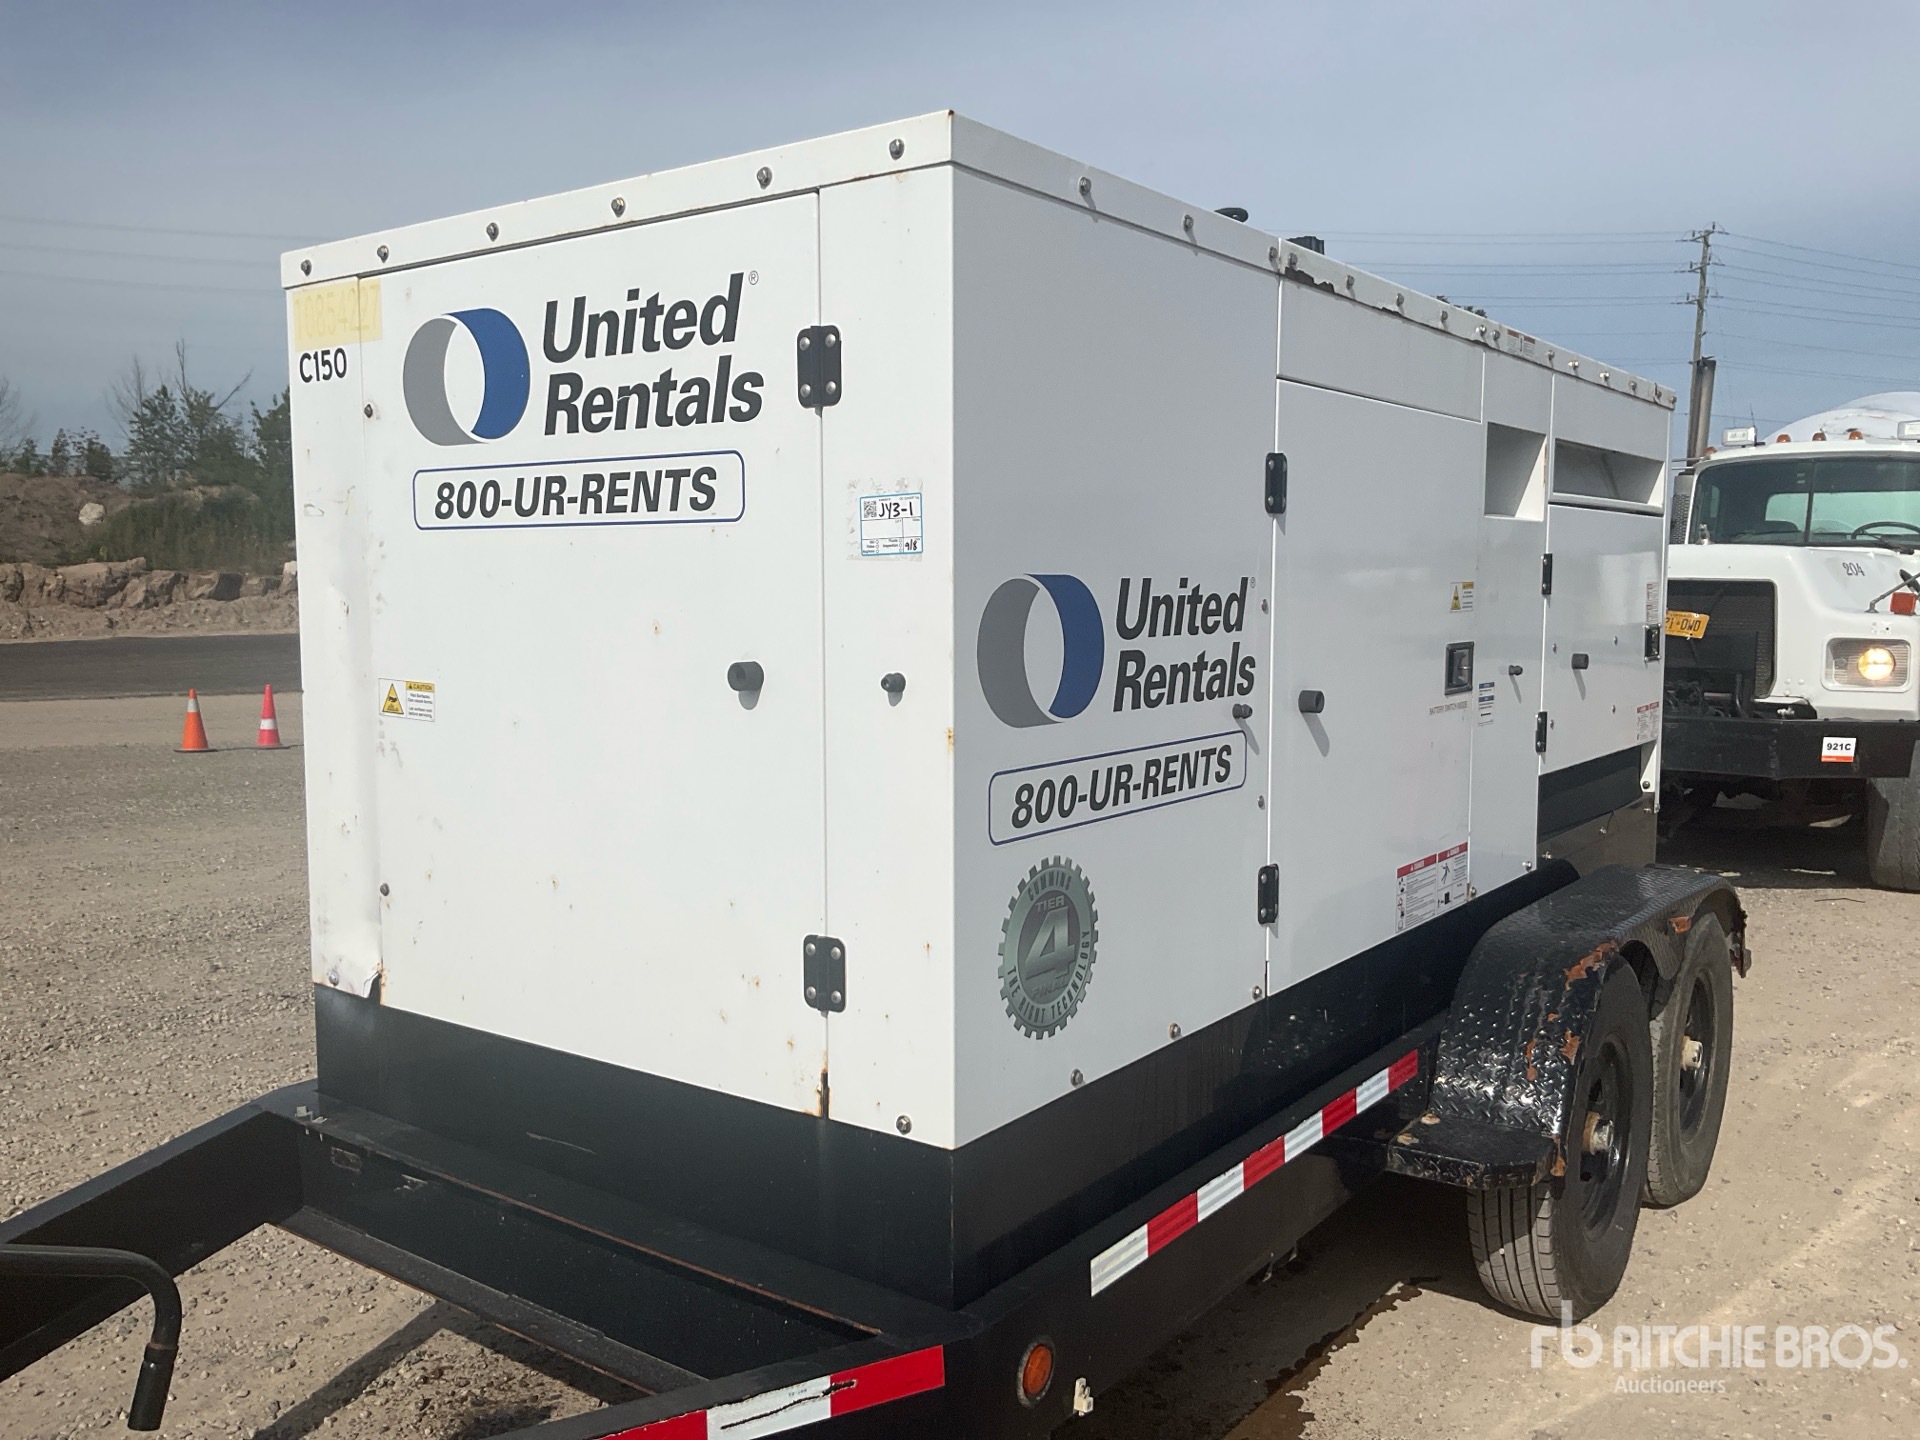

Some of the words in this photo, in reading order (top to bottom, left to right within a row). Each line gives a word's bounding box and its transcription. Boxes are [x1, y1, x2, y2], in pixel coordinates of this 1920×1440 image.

[542, 272, 745, 363] United
[299, 347, 347, 383] C150
[544, 354, 765, 436] Rentals
[434, 466, 717, 520] 800-UR-RENTS
[1842, 562, 1865, 577] 204
[1115, 576, 1249, 640] United
[1113, 641, 1256, 713] Rentals
[1826, 742, 1852, 751] 921C
[1011, 744, 1232, 829] 800-UR-RENTS
[1035, 894, 1066, 913] TIER
[1007, 965, 1022, 998] THE
[1018, 998, 1046, 1024] RIGHT
[1050, 930, 1091, 1021] TECHNOLOGY
[1025, 905, 1077, 981] 4
